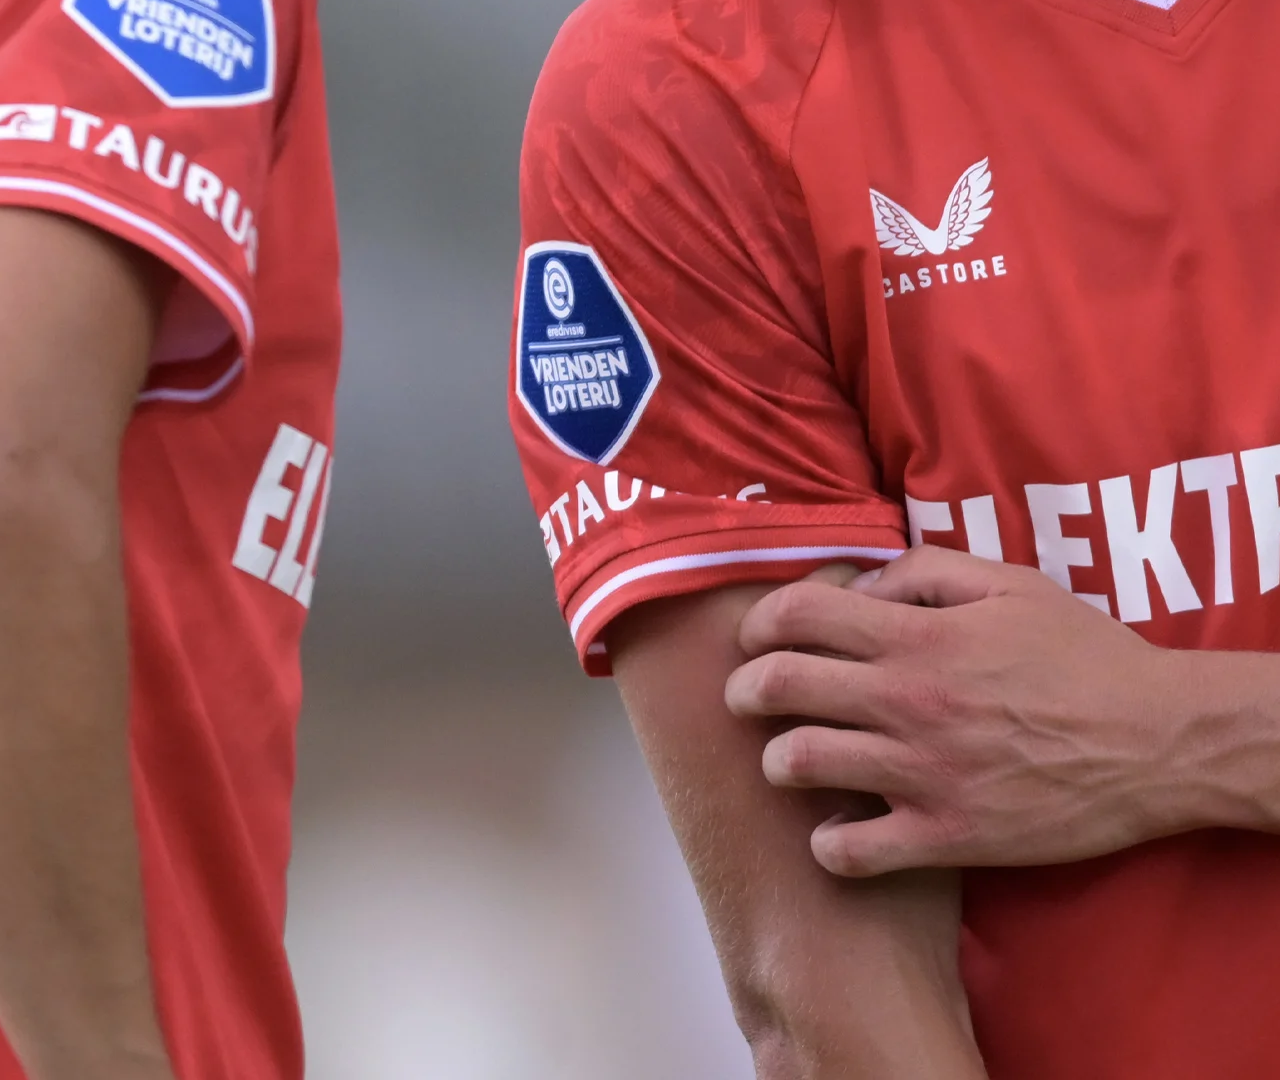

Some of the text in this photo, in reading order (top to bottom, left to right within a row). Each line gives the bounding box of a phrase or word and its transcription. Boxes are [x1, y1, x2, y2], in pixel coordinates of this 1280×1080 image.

[119, 13, 234, 81] LOTERIJ
[882, 255, 1007, 298] CASTORE
[547, 322, 585, 338] eredivisie
[529, 349, 629, 385] VRIENDEN
[543, 378, 621, 415] LOTERIJ
